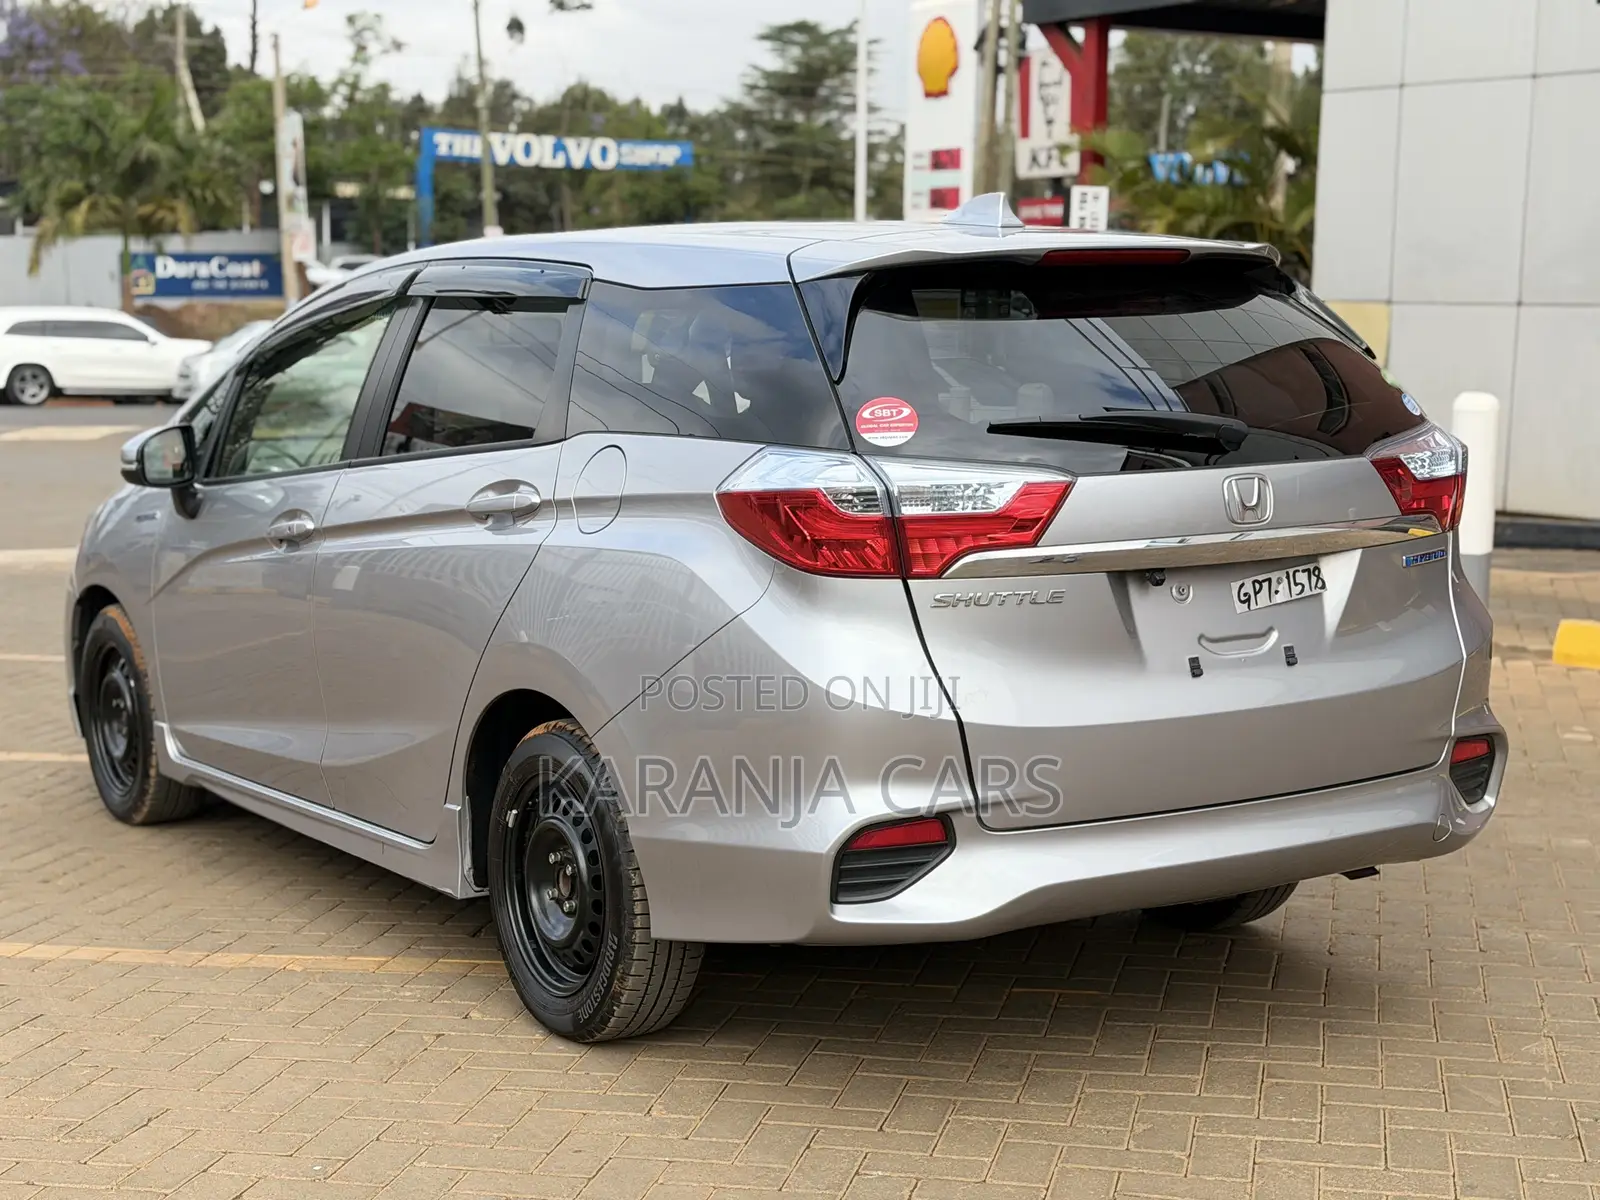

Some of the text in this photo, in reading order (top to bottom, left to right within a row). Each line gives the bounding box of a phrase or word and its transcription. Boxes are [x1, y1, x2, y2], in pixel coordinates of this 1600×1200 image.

[487, 132, 618, 170] VOLVO
[874, 408, 899, 417] SBT
[930, 589, 1067, 608] SHUTTLE
